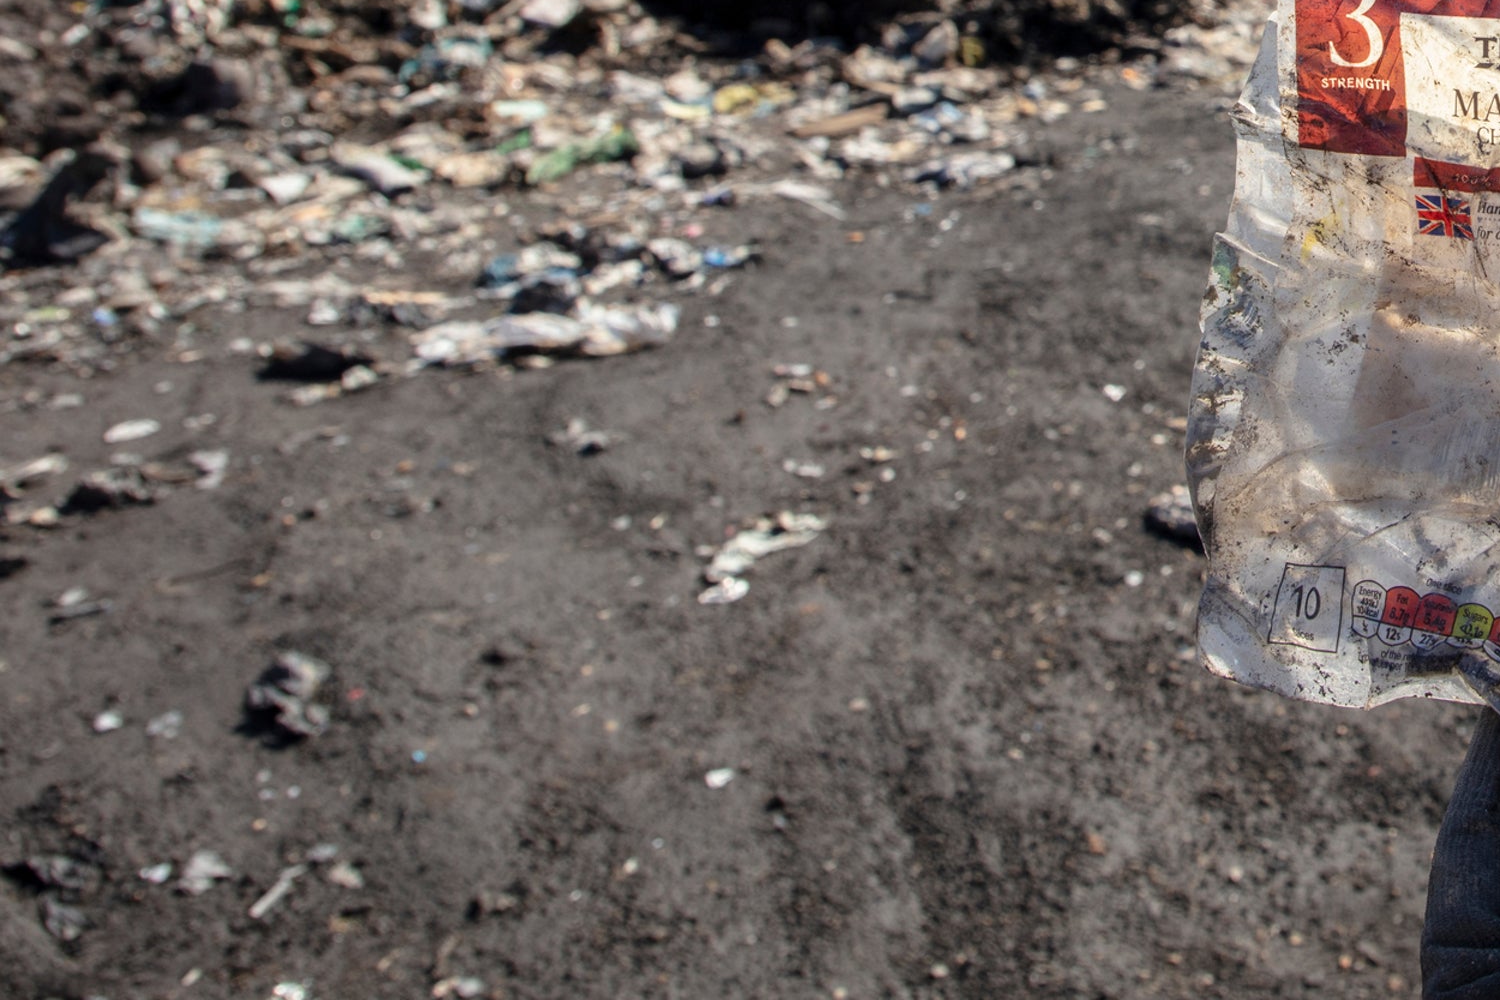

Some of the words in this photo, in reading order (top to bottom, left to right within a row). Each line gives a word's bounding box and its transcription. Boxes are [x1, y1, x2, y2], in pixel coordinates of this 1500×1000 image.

[1321, 77, 1391, 92] STRENGTH
[1359, 586, 1382, 600] Energy
[1290, 585, 1321, 620] 10
[1462, 608, 1488, 624] Sugars
